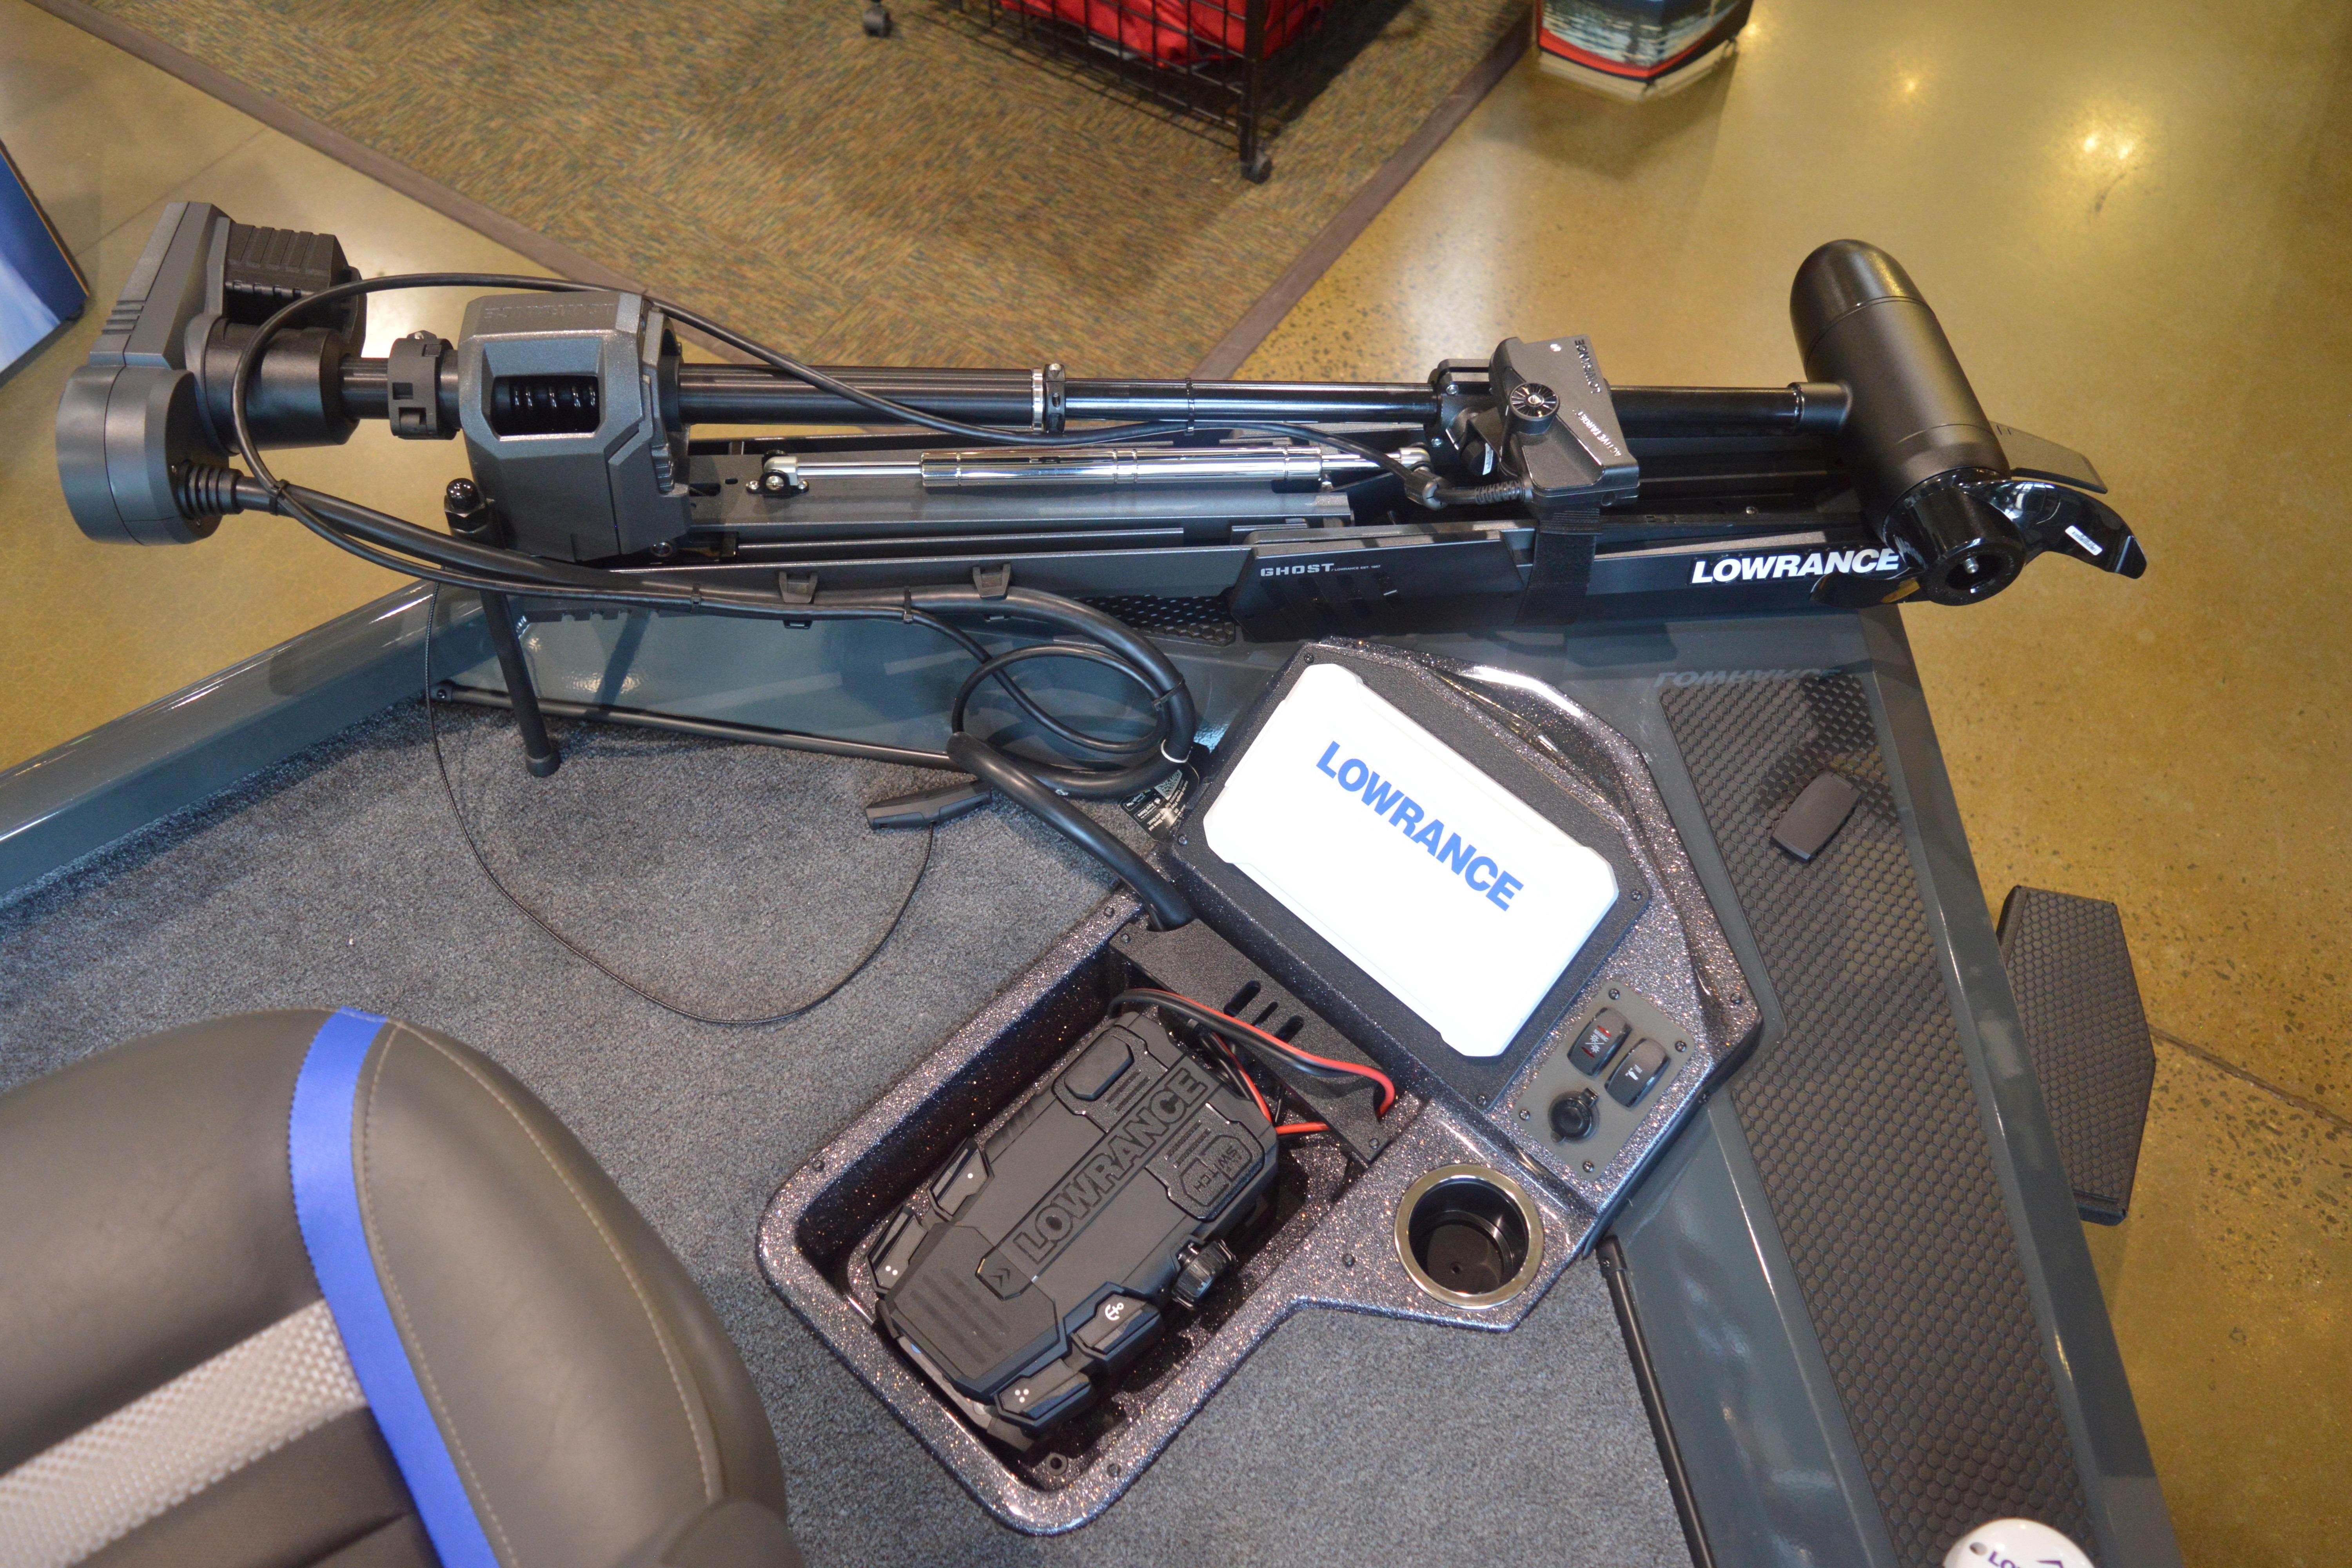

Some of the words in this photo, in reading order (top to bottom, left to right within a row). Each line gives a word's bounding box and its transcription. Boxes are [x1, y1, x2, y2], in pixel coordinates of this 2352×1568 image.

[1575, 339, 1602, 394] LOWRANCE
[1260, 563, 1335, 577] GHOST
[1691, 548, 1900, 584] LOWRANCE
[1132, 793, 1144, 802] Google
[1137, 808, 1148, 817] Store
[1316, 740, 1524, 912] LOWRANCE
[1013, 1067, 1209, 1264] LOWRANCE
[1193, 1145, 1237, 1192] SWITCH
[1988, 1550, 2021, 1568] LO
